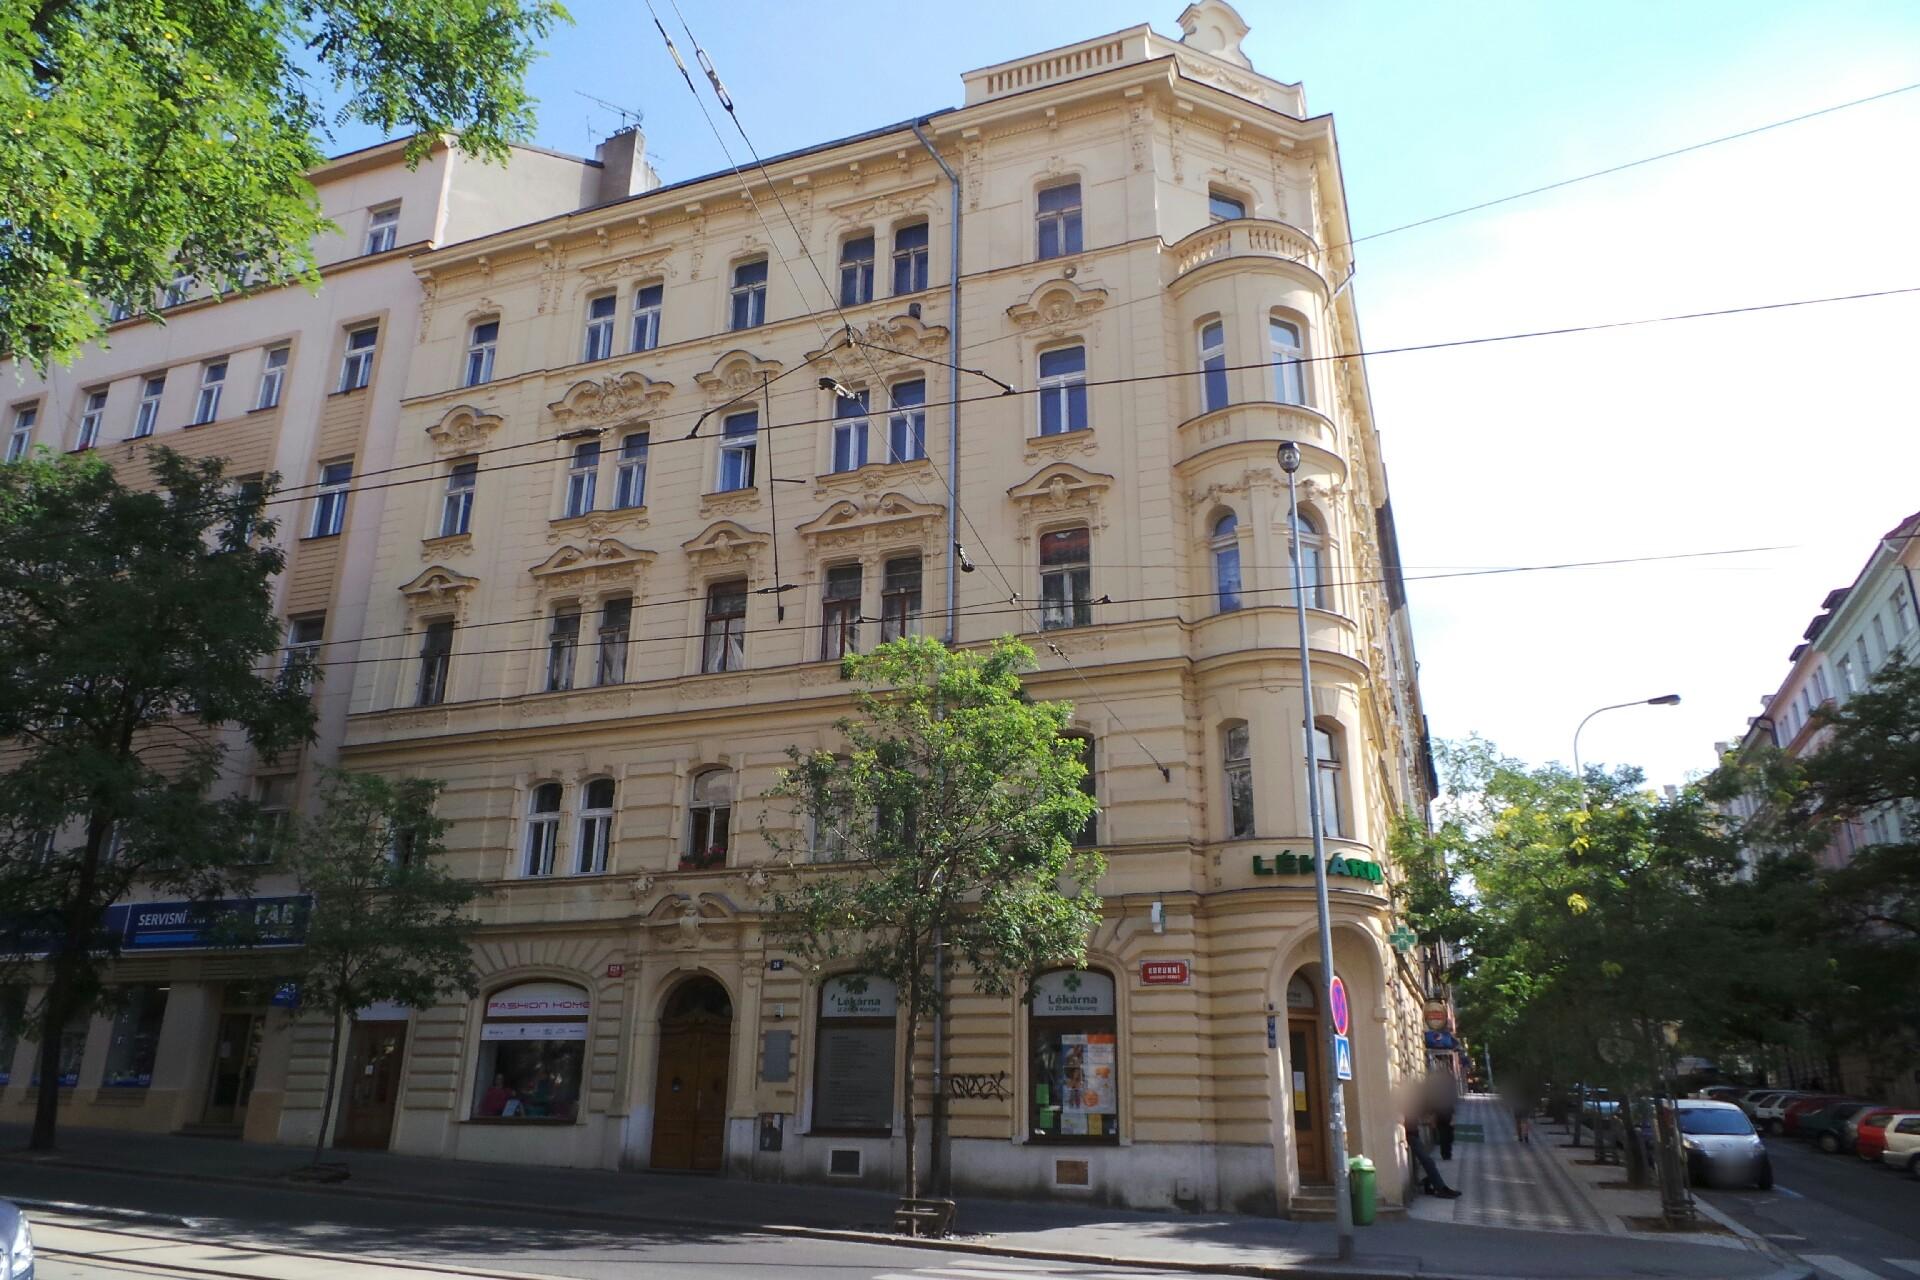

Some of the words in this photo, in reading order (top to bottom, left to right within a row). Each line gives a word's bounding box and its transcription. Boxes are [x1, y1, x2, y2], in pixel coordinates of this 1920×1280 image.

[137, 909, 188, 926] SERVISNÍ
[1048, 993, 1098, 1005] Lékárna
[489, 1002, 548, 1010] FASHION
[552, 1001, 592, 1009] HOME
